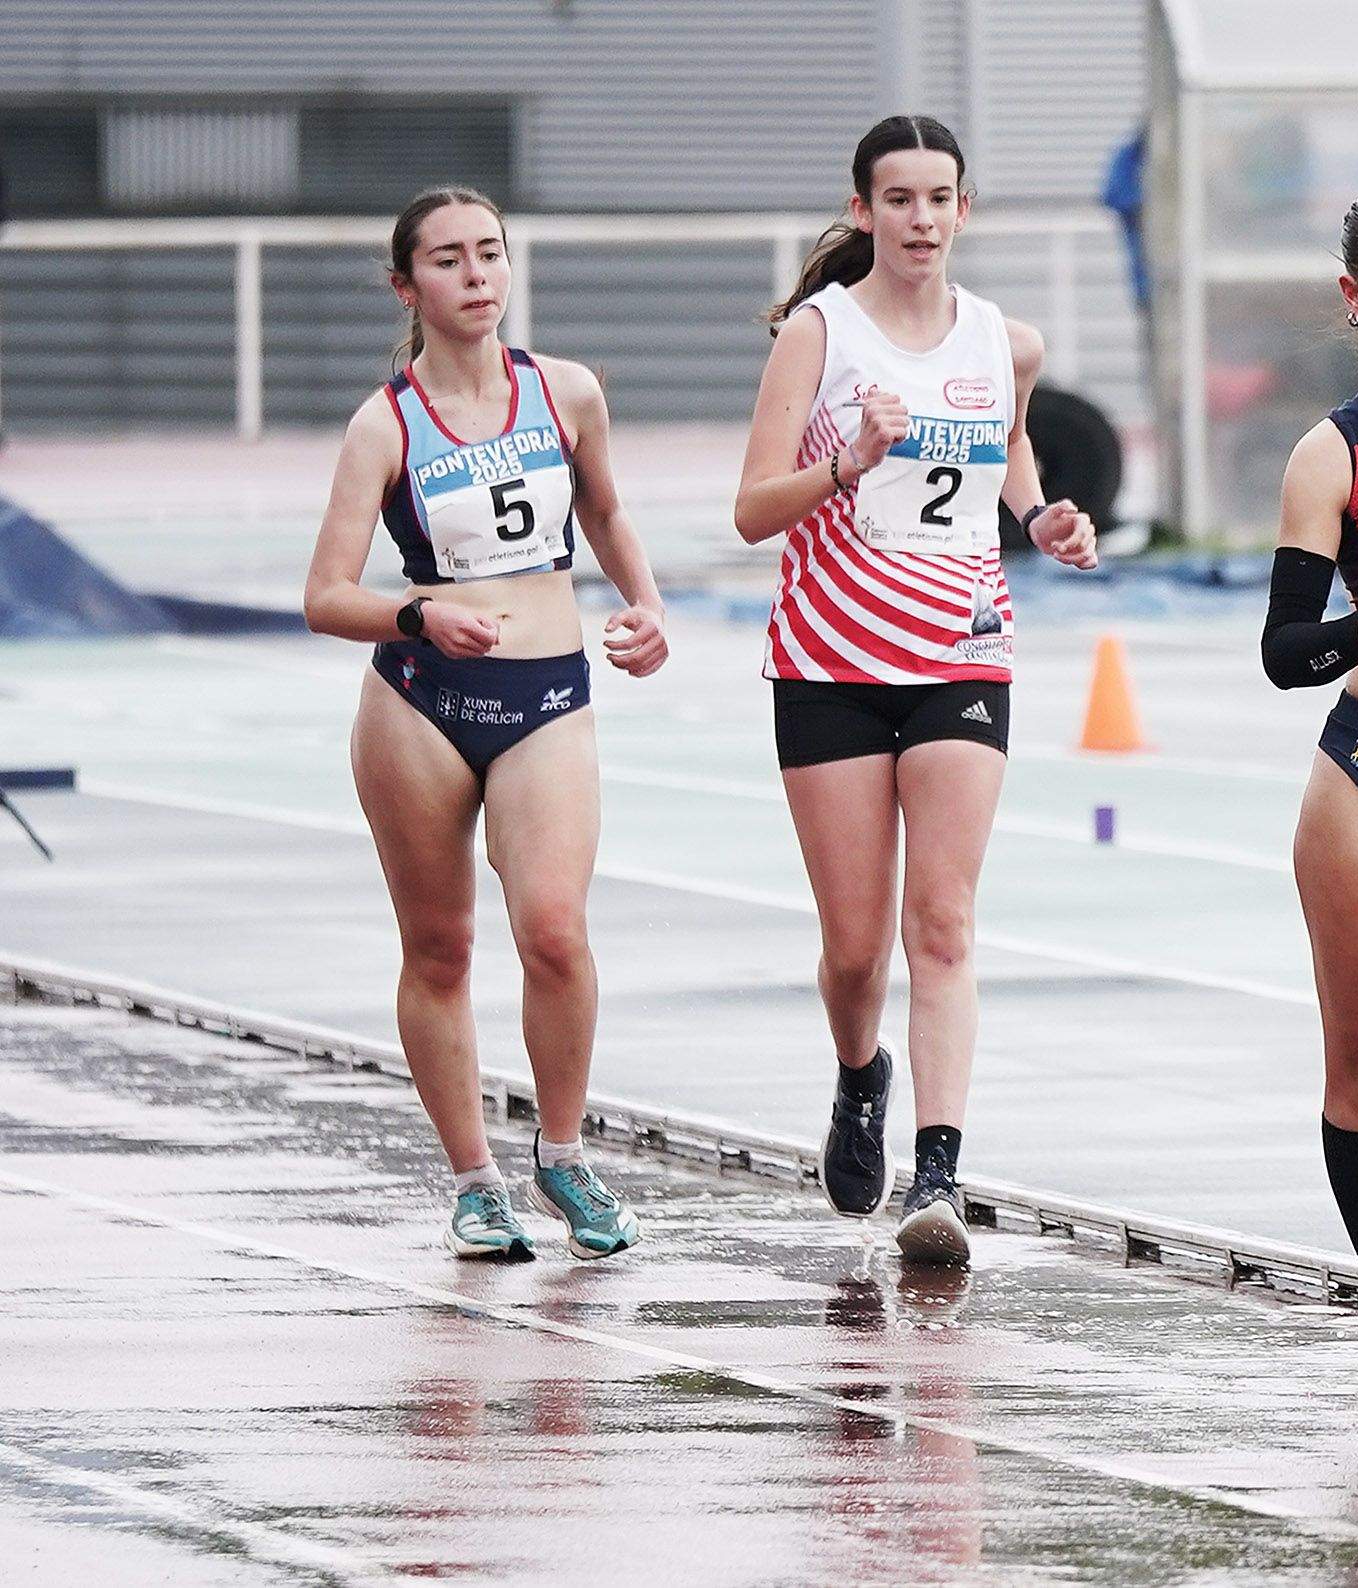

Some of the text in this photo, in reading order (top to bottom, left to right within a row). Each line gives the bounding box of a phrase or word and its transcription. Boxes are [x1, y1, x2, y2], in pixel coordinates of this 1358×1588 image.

[907, 419, 1006, 447] NTEVEDRA
[417, 428, 560, 486] PONTEVEDRA
[919, 442, 971, 464] 2025
[470, 457, 524, 485] 2025
[489, 478, 536, 543] 5
[920, 466, 963, 527] 2
[461, 709, 524, 725] DE GALICIA
[463, 696, 503, 712] XUNTA
